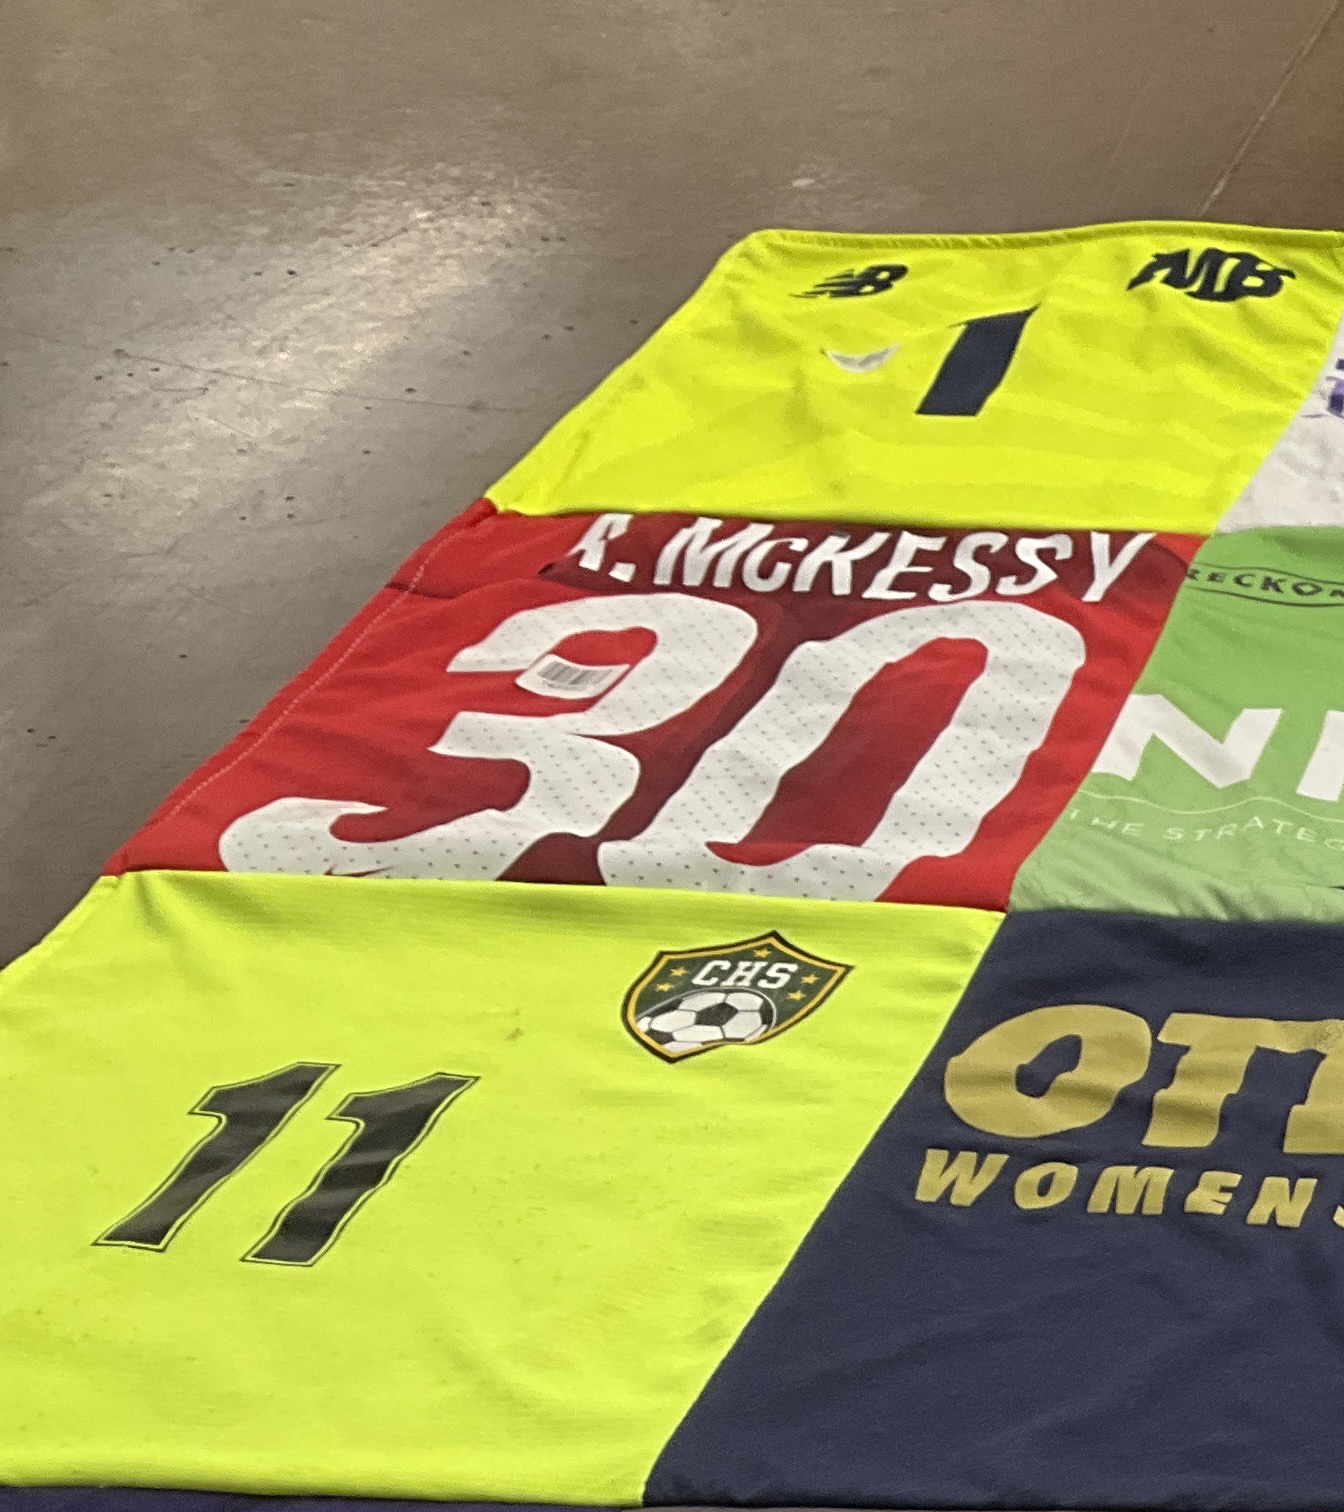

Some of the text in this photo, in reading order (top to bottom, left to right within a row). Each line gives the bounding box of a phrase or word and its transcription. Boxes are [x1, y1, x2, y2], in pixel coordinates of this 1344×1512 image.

[217, 592, 1086, 903] 30
[691, 959, 800, 990] CHS
[91, 1060, 481, 1267] 11
